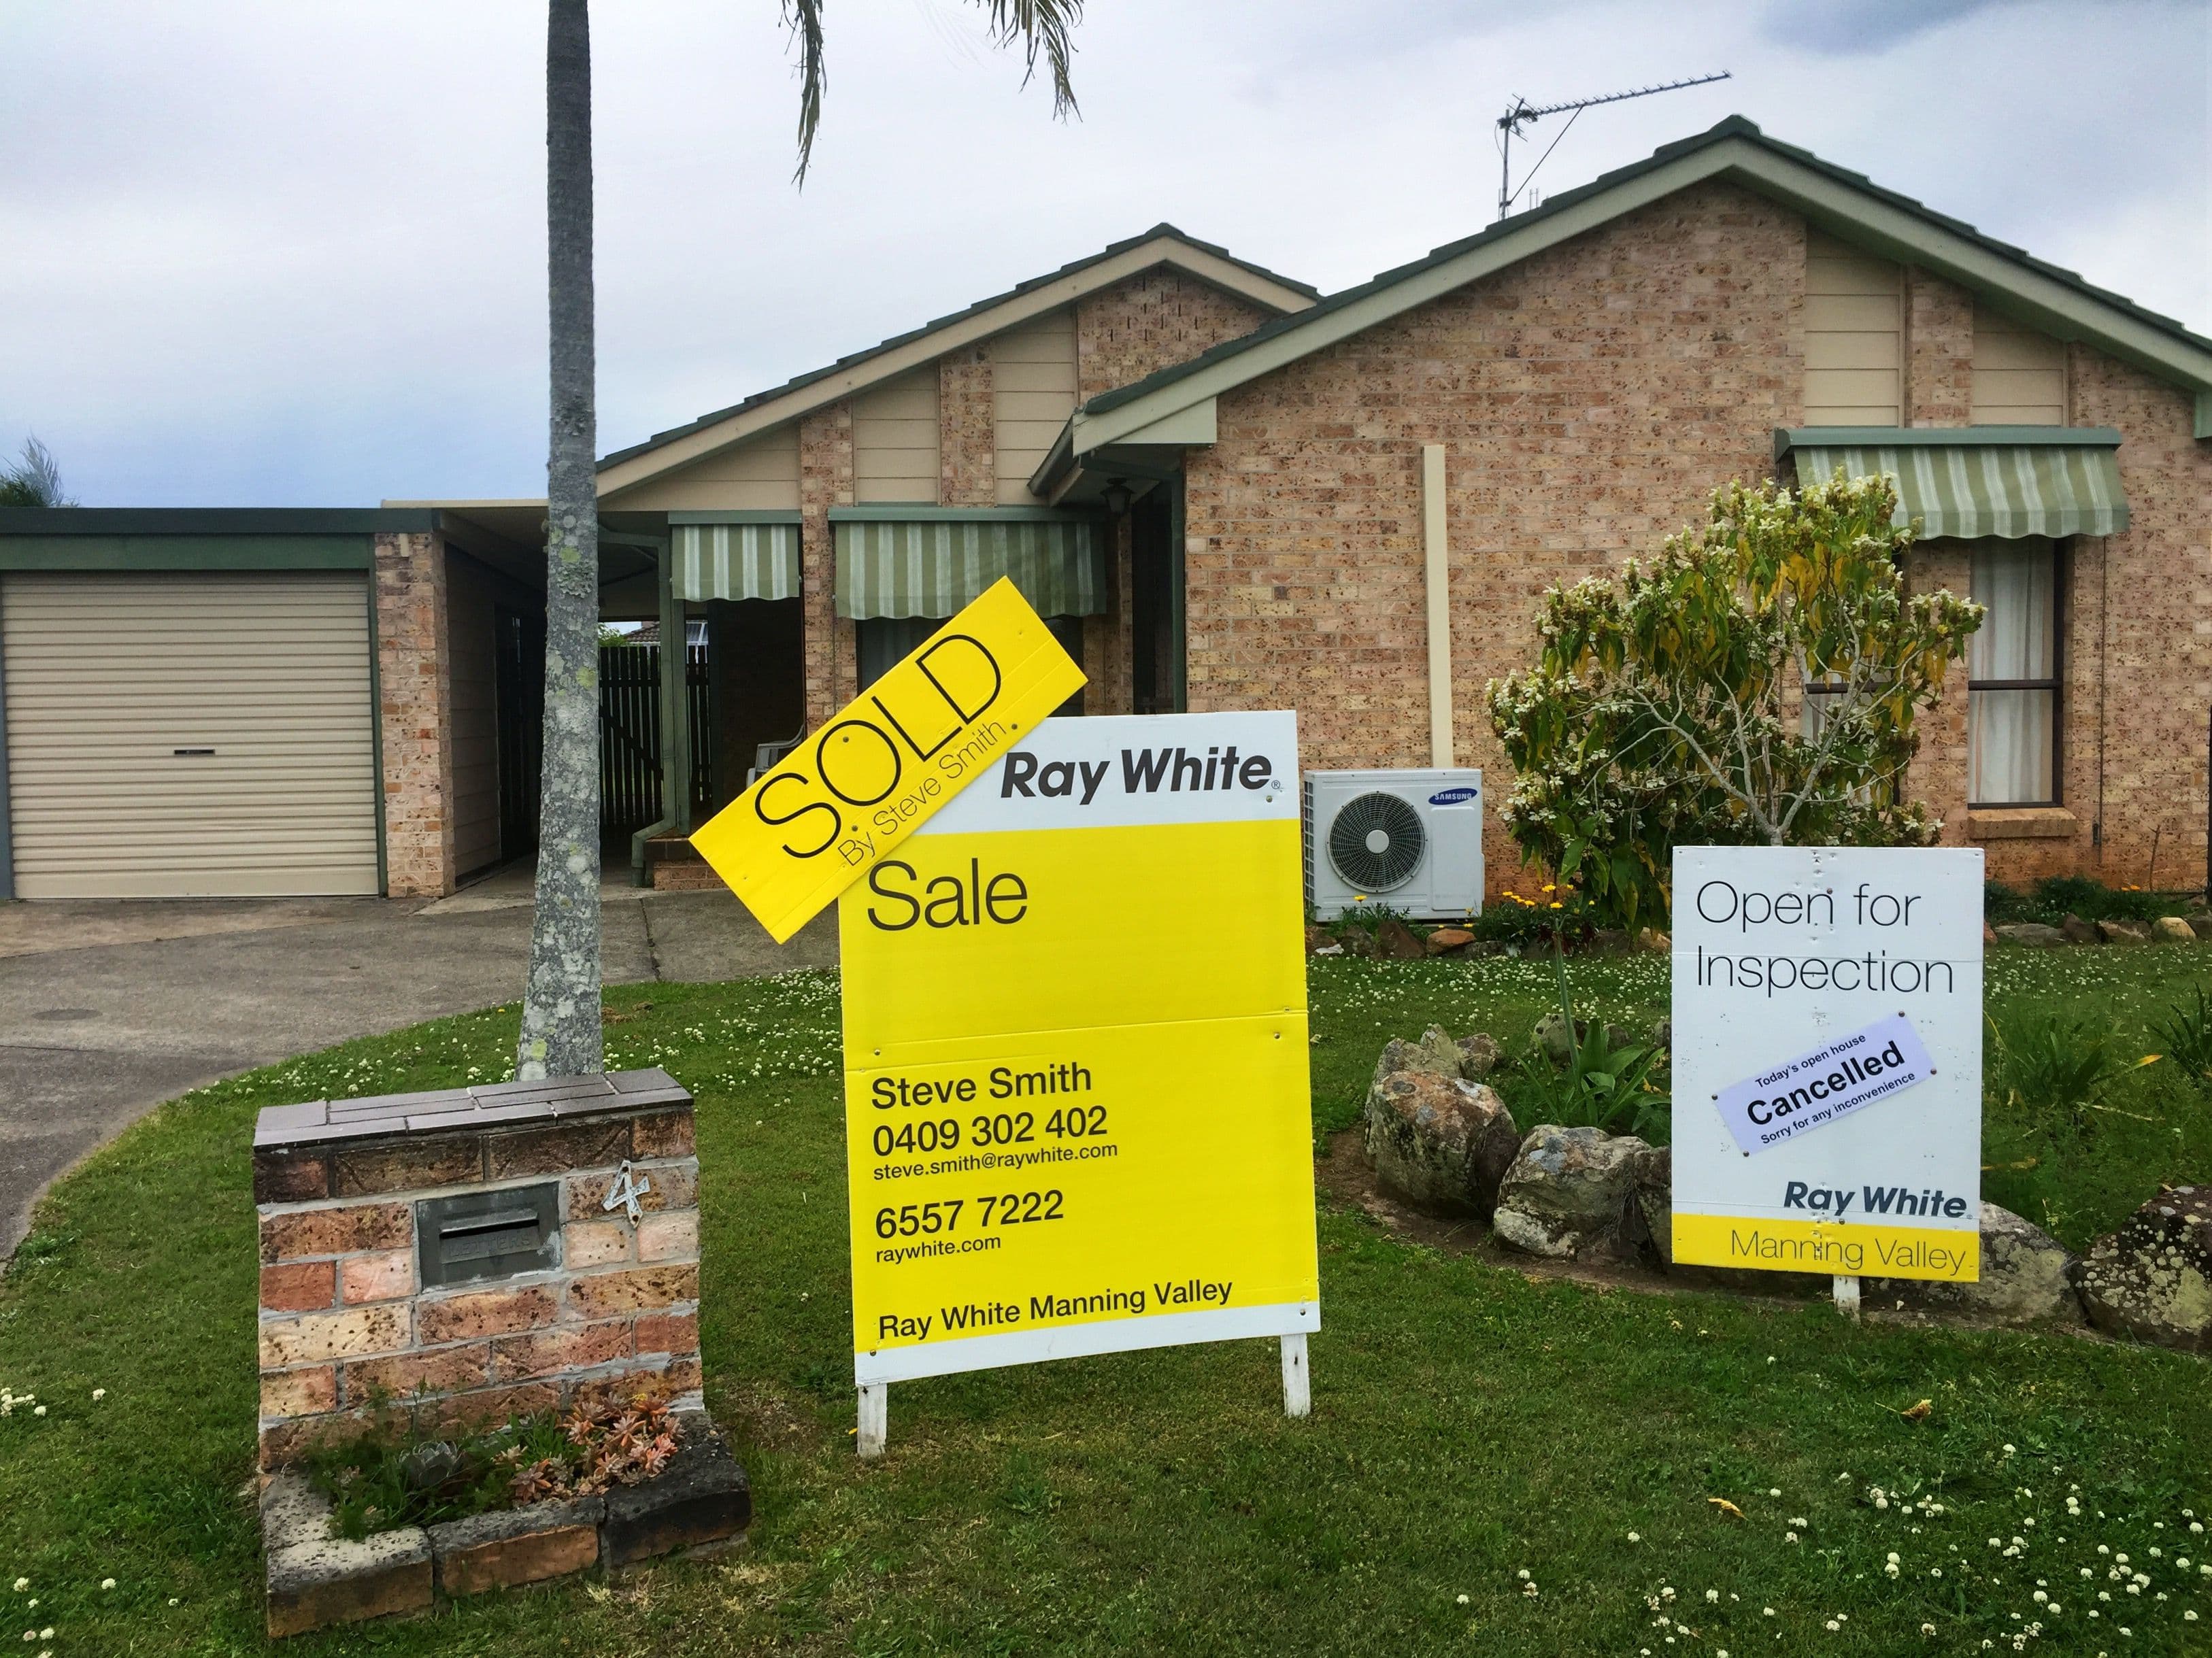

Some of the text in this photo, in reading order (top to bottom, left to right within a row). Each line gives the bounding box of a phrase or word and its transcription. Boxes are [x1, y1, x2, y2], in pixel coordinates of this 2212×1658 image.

[755, 635, 1001, 858] SOLD
[838, 723, 1007, 868] By Steve Smith
[1001, 747, 1271, 805] Ray White
[867, 858, 1028, 931] Sale
[1697, 881, 1921, 932] Open for
[1698, 945, 1953, 998] Inspection
[871, 1062, 1091, 1110] Steve Smith
[1747, 1041, 1905, 1126] Cancelled
[1756, 1034, 1866, 1089] Today's open house
[873, 1105, 1107, 1156] 0409 302 402
[1761, 1072, 1915, 1145] Sorry for any inconvenience
[873, 1142, 1118, 1181] steve.smith@raywhite.com
[601, 1160, 650, 1228] 4
[875, 1189, 1064, 1239] 6557 7222
[1783, 1181, 1966, 1218] Ray White
[875, 1235, 1001, 1264] raywhite.com
[1731, 1230, 1966, 1276] Manning Valley
[879, 1279, 1233, 1341] Ray White Manning Valley
